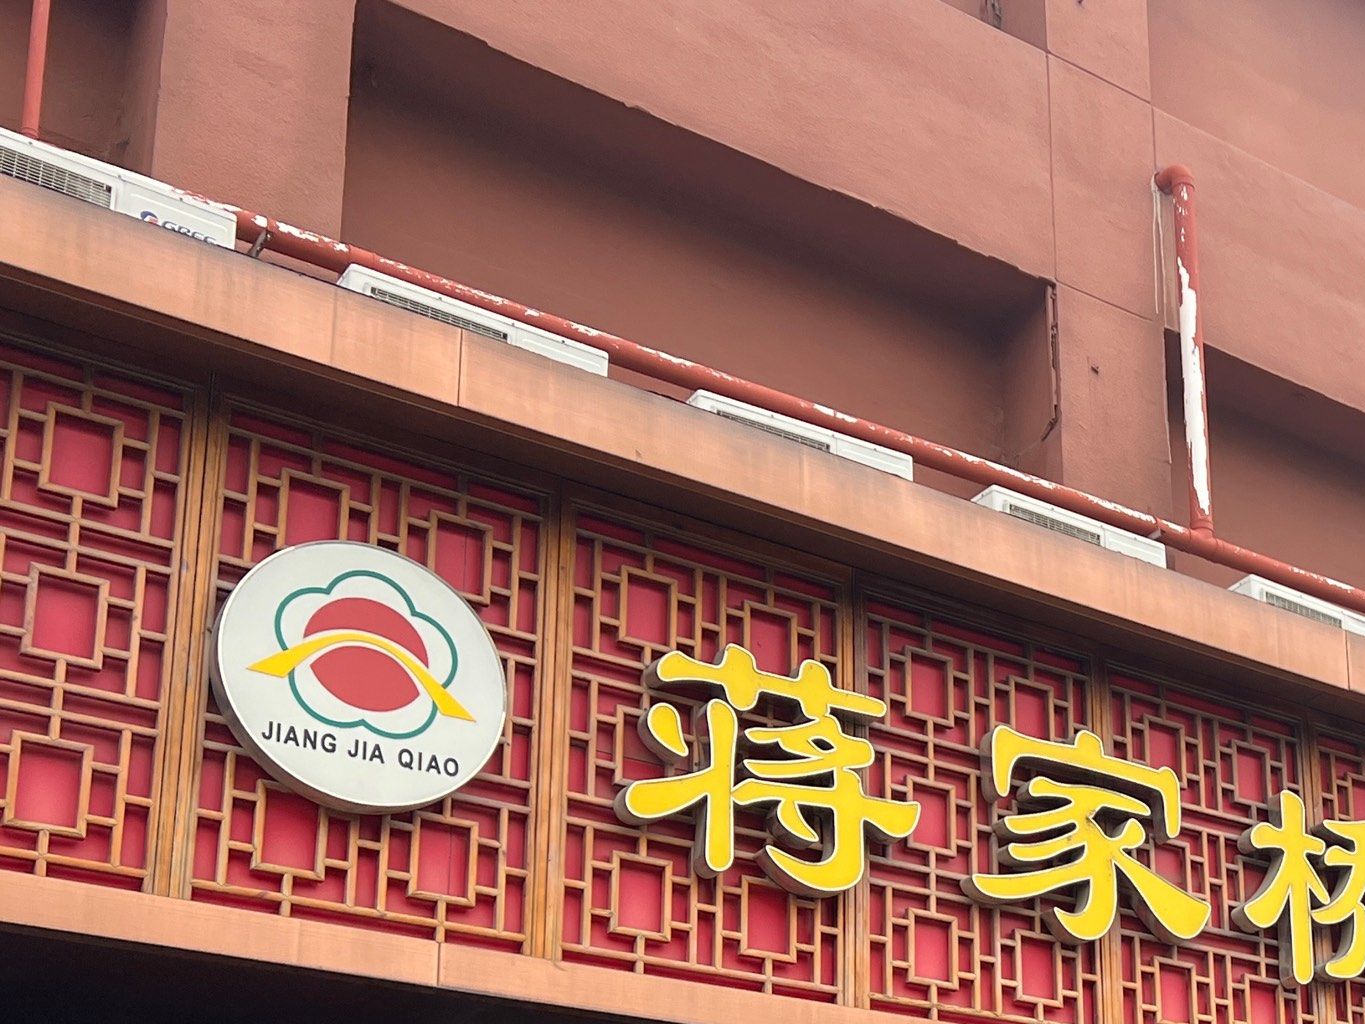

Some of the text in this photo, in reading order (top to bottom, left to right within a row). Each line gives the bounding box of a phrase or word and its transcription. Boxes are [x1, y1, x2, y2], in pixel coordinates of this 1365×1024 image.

[262, 721, 460, 777] JIANG JIA QIAO
